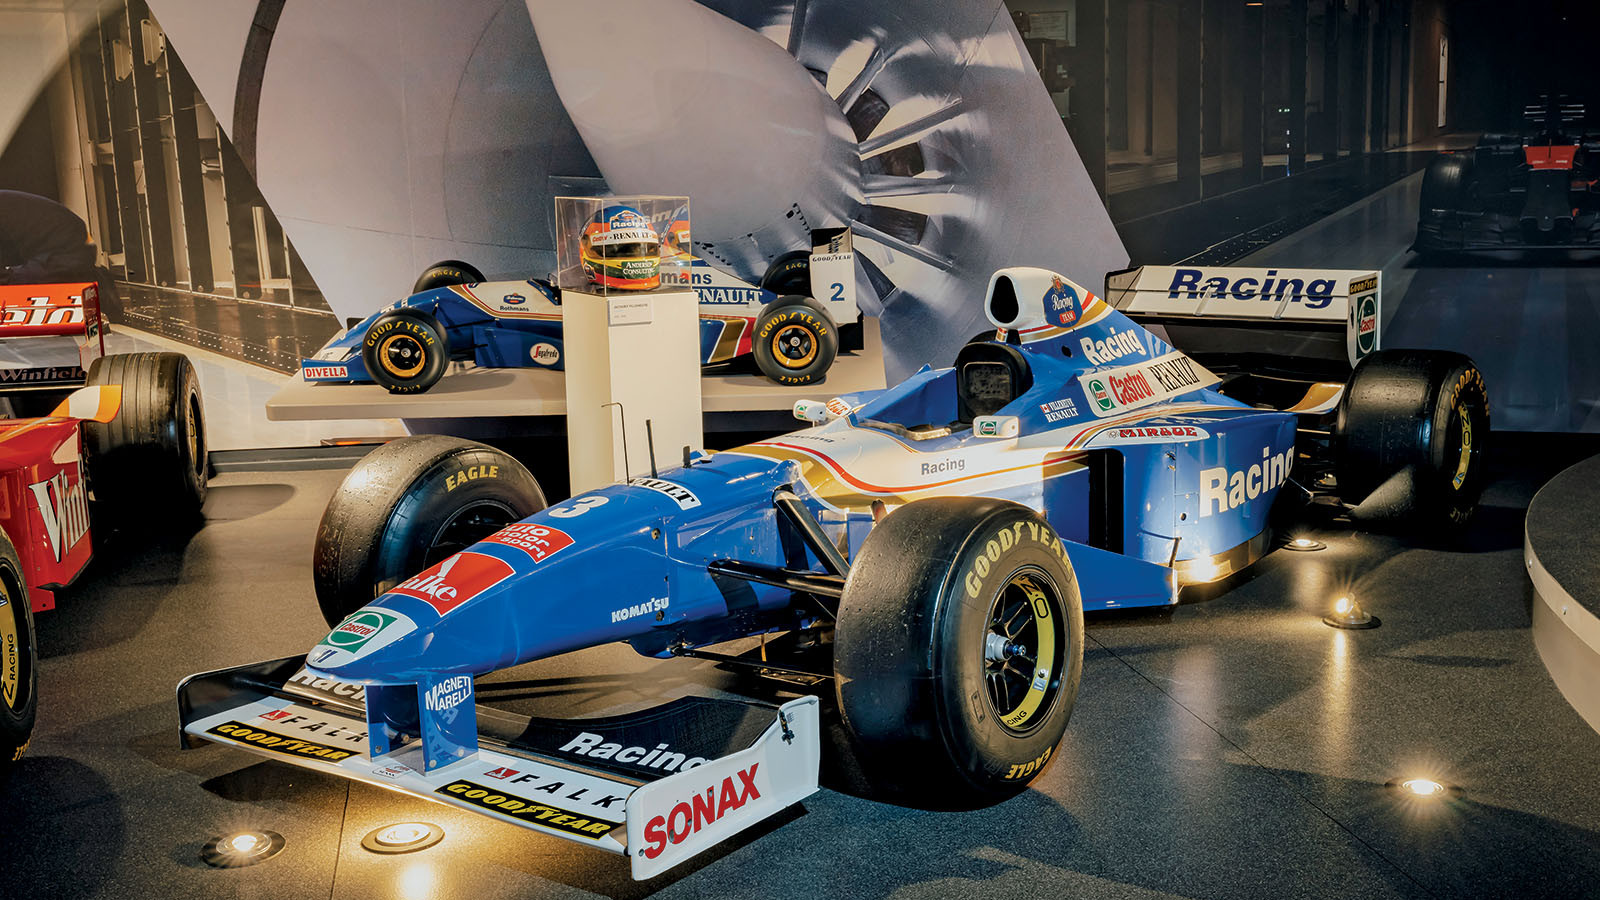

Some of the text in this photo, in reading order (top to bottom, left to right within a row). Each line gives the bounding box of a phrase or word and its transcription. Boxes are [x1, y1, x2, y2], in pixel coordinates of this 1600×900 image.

[830, 282, 845, 302] 2
[1168, 269, 1337, 309] Racing
[1051, 293, 1074, 311] Racing
[1080, 327, 1147, 366] Racing
[305, 367, 347, 378] DIVELLA
[1109, 356, 1201, 406] Castrol RENAULT
[1045, 407, 1079, 423] RENAULT
[1119, 427, 1198, 438] MIRAGE
[921, 458, 966, 475] Racing
[446, 465, 499, 492] EAGLE
[549, 496, 609, 518] 3
[612, 597, 669, 624] KOMATSU
[340, 622, 376, 636] Castrol
[1005, 746, 1052, 779] EAGLE
[643, 762, 761, 860] SONAX
